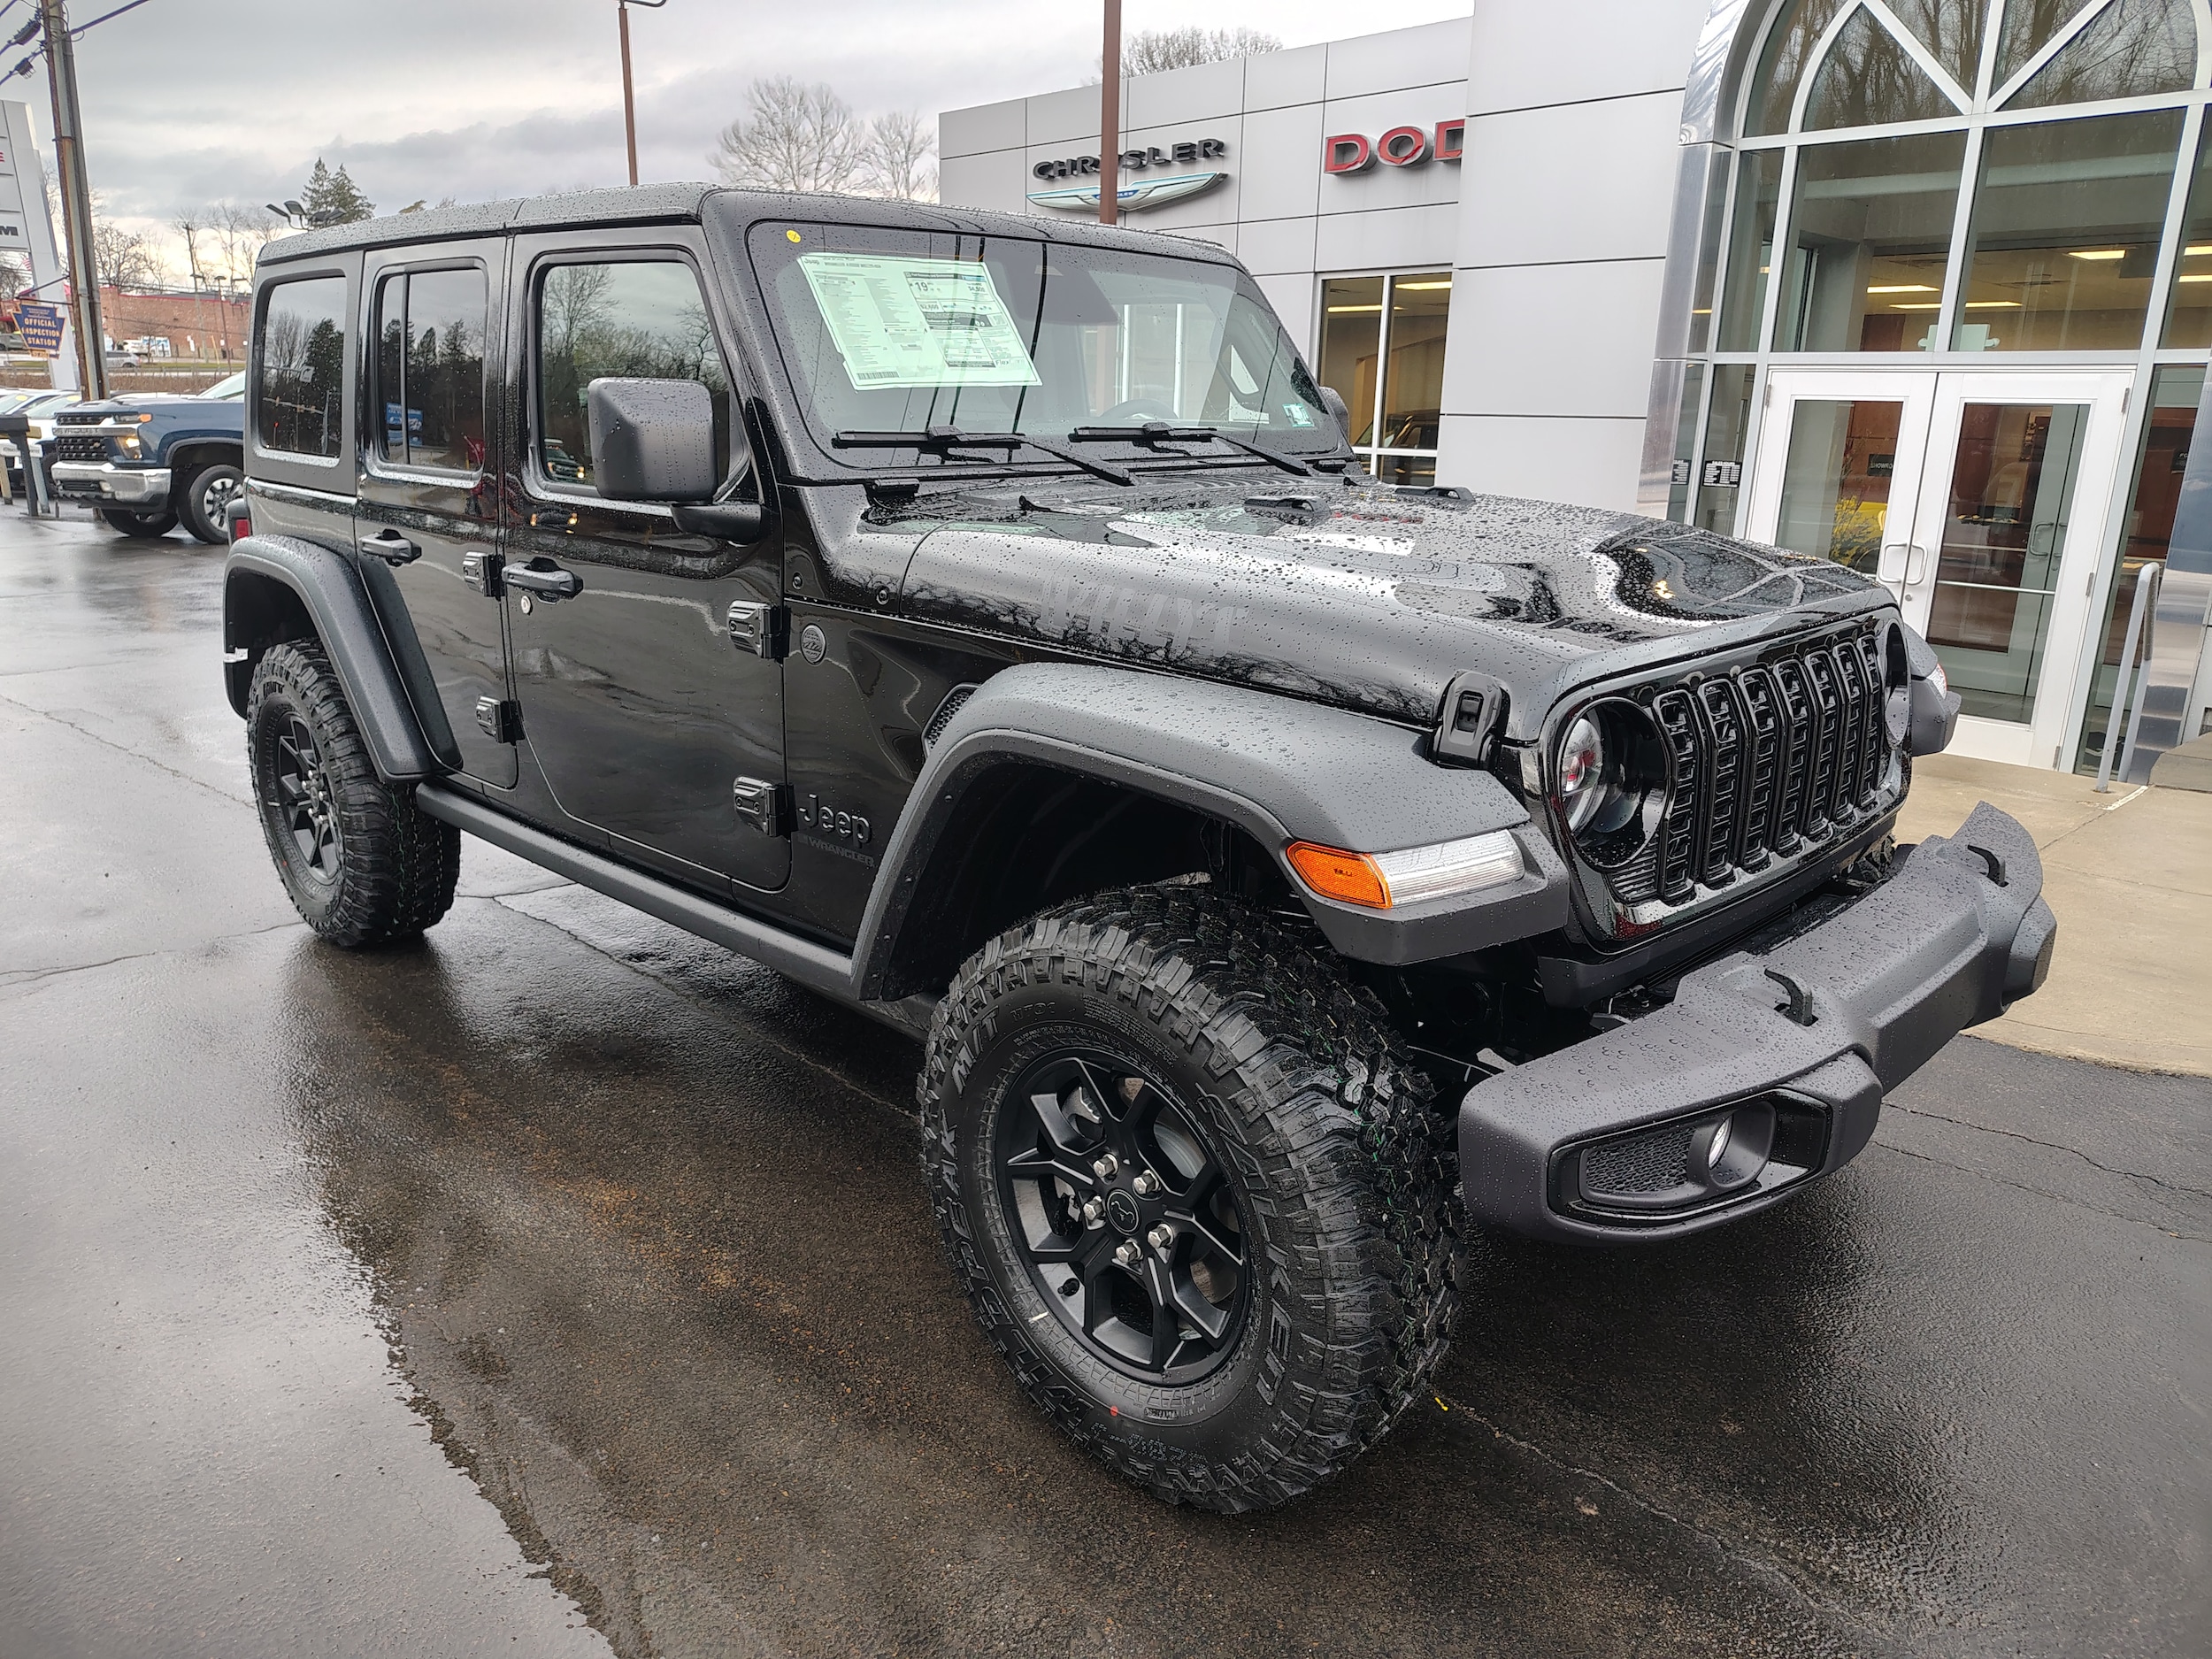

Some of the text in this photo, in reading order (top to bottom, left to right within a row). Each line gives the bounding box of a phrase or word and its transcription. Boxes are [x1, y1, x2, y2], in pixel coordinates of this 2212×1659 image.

[1033, 138, 1225, 180] CHRSLER
[914, 281, 929, 292] 19
[22, 327, 60, 337] INSPECTION
[24, 318, 57, 327] OFFICIAL
[27, 337, 57, 346] STATION
[798, 794, 872, 849] Jeep
[806, 834, 876, 868] WRANGLER
[939, 1108, 1094, 1428] WILDPEAK
